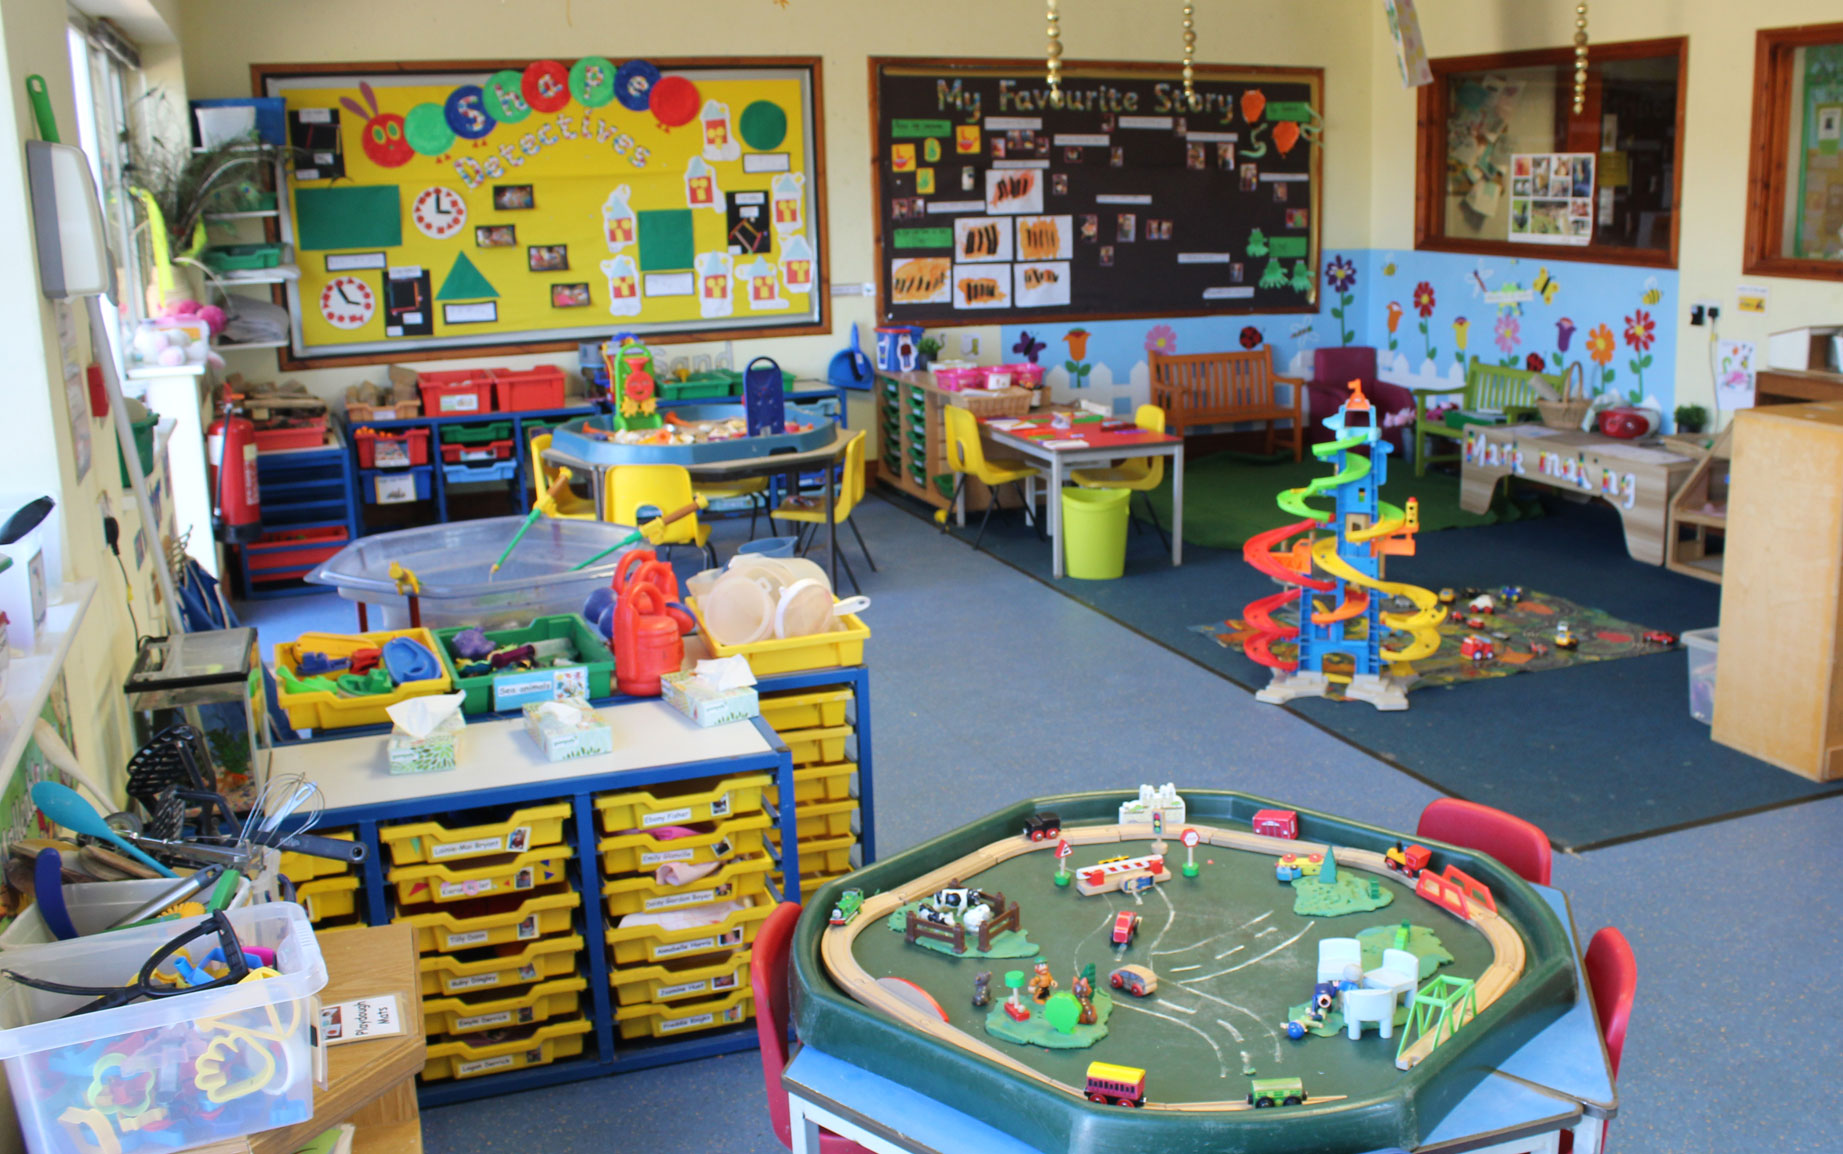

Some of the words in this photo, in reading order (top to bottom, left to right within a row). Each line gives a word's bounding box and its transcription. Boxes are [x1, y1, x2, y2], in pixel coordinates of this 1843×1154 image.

[457, 65, 650, 132] Shape
[937, 79, 981, 124] My
[1000, 79, 1138, 112] Favourite
[1153, 83, 1233, 125] Story
[453, 107, 651, 189] Detectives
[1467, 429, 1526, 475] Mark
[1539, 450, 1636, 510] makng
[519, 682, 551, 692] animals
[353, 1000, 373, 1036] Playdough
[377, 1006, 390, 1025] Mats
